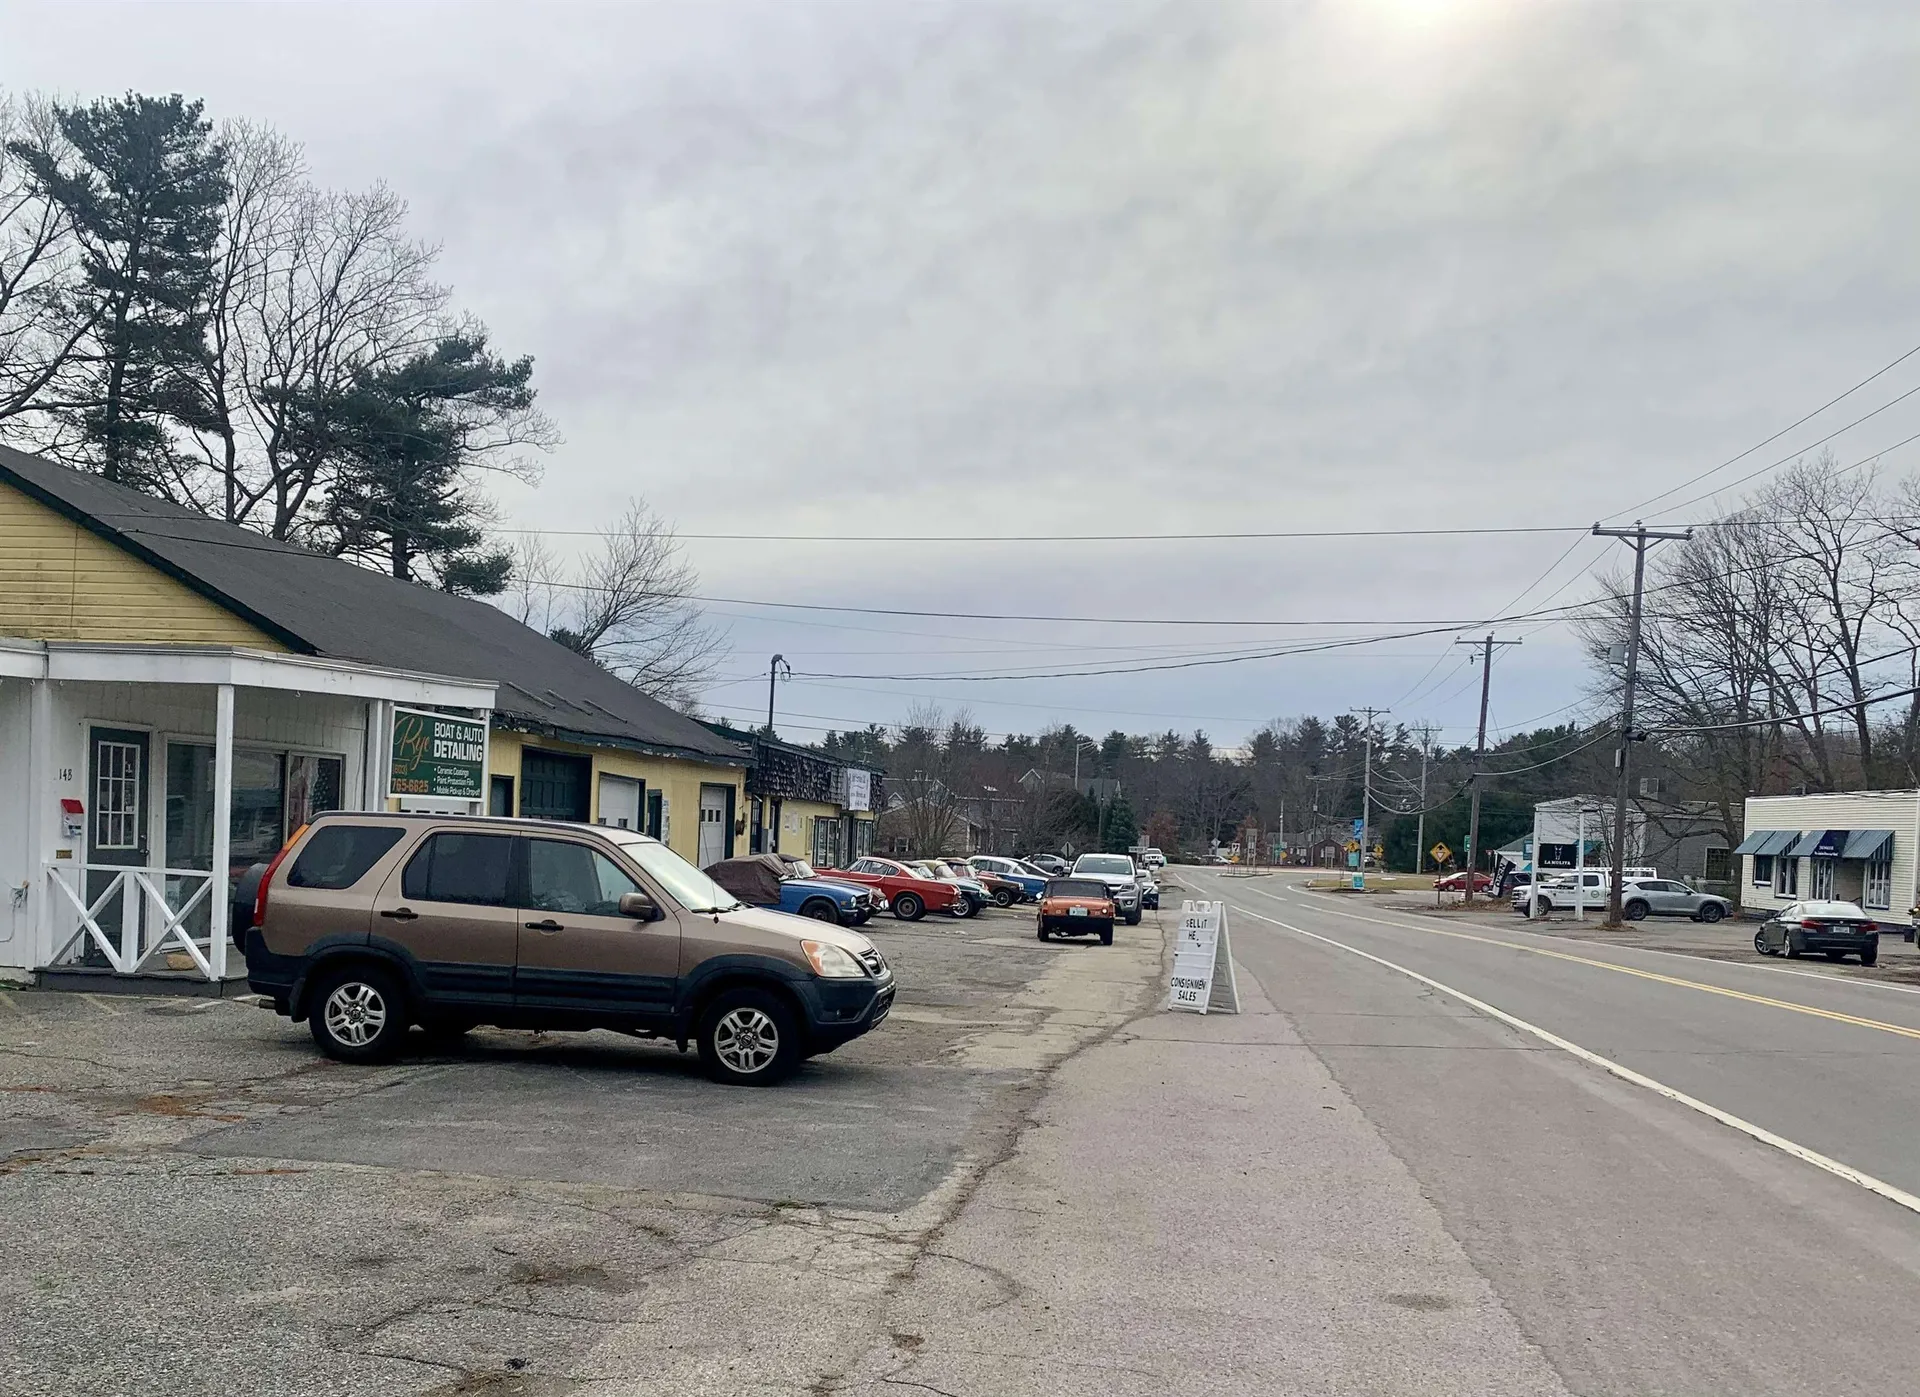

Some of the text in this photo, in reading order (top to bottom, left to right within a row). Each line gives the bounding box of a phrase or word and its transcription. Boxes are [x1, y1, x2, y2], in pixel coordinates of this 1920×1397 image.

[393, 714, 430, 771] Rye
[434, 722, 484, 743] BOAT & AUTO
[433, 739, 483, 762] DETAILING
[1495, 863, 1506, 888] OPEN
[1186, 918, 1200, 929] SELL
[1178, 990, 1197, 1002] SALES
